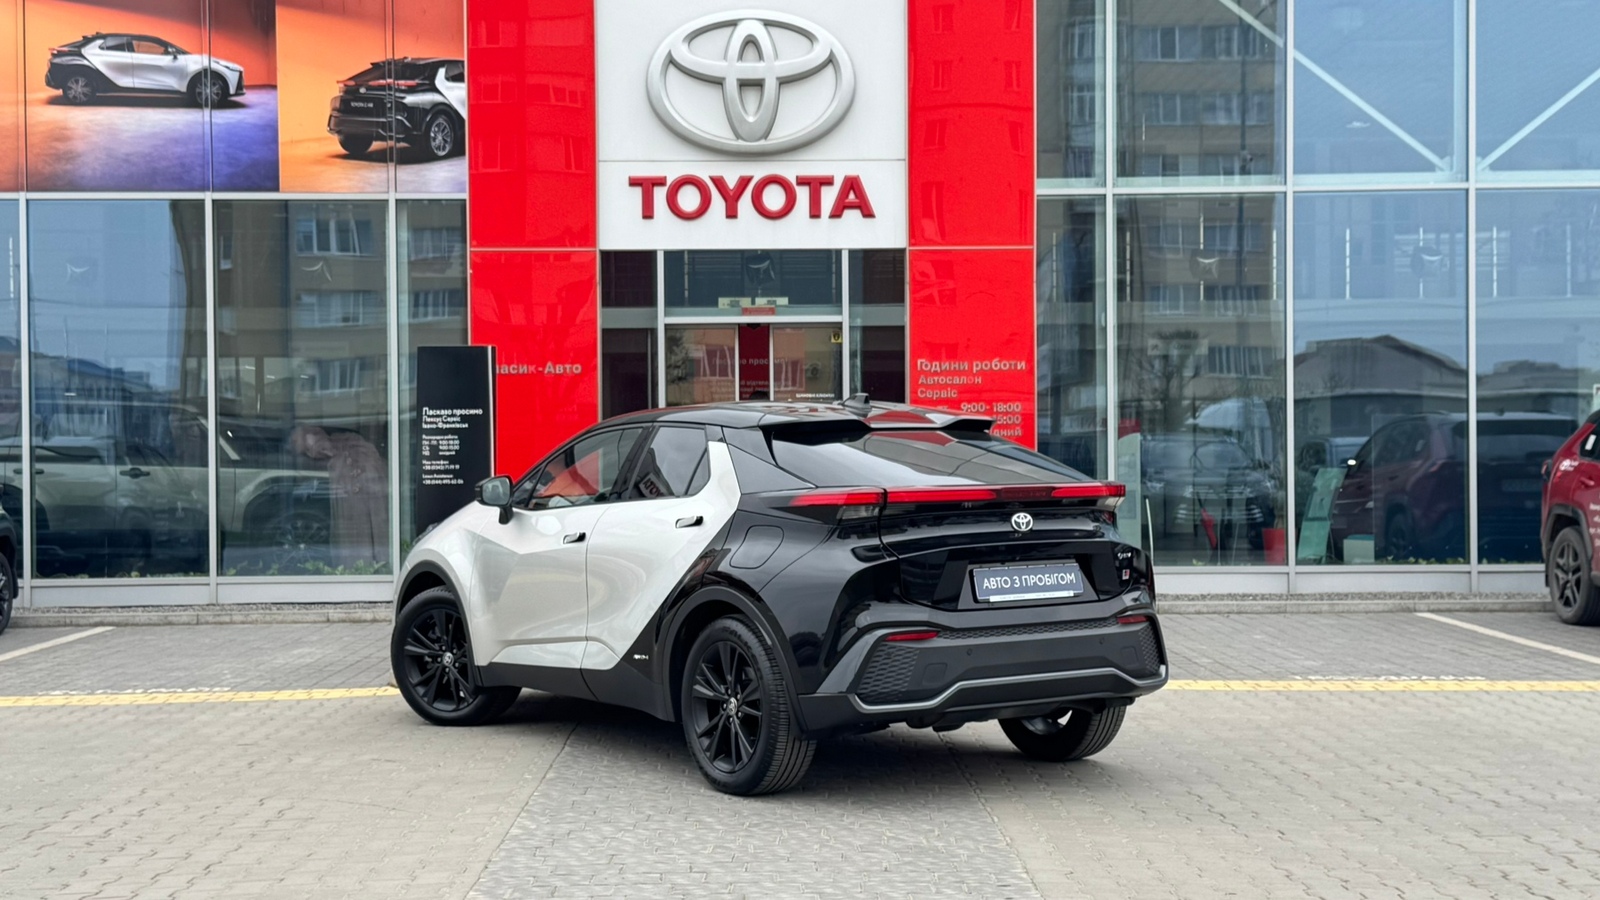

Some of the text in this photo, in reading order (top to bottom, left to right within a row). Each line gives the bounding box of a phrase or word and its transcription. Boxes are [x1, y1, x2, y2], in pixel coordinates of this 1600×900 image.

[628, 174, 876, 221] TOYOTA
[917, 358, 1026, 373] Години роботи
[918, 375, 982, 384] Автосалон
[918, 388, 958, 400] Сервіс
[453, 408, 483, 416] просимо
[983, 572, 1076, 590] АВТО З ПРОБІГОМ
